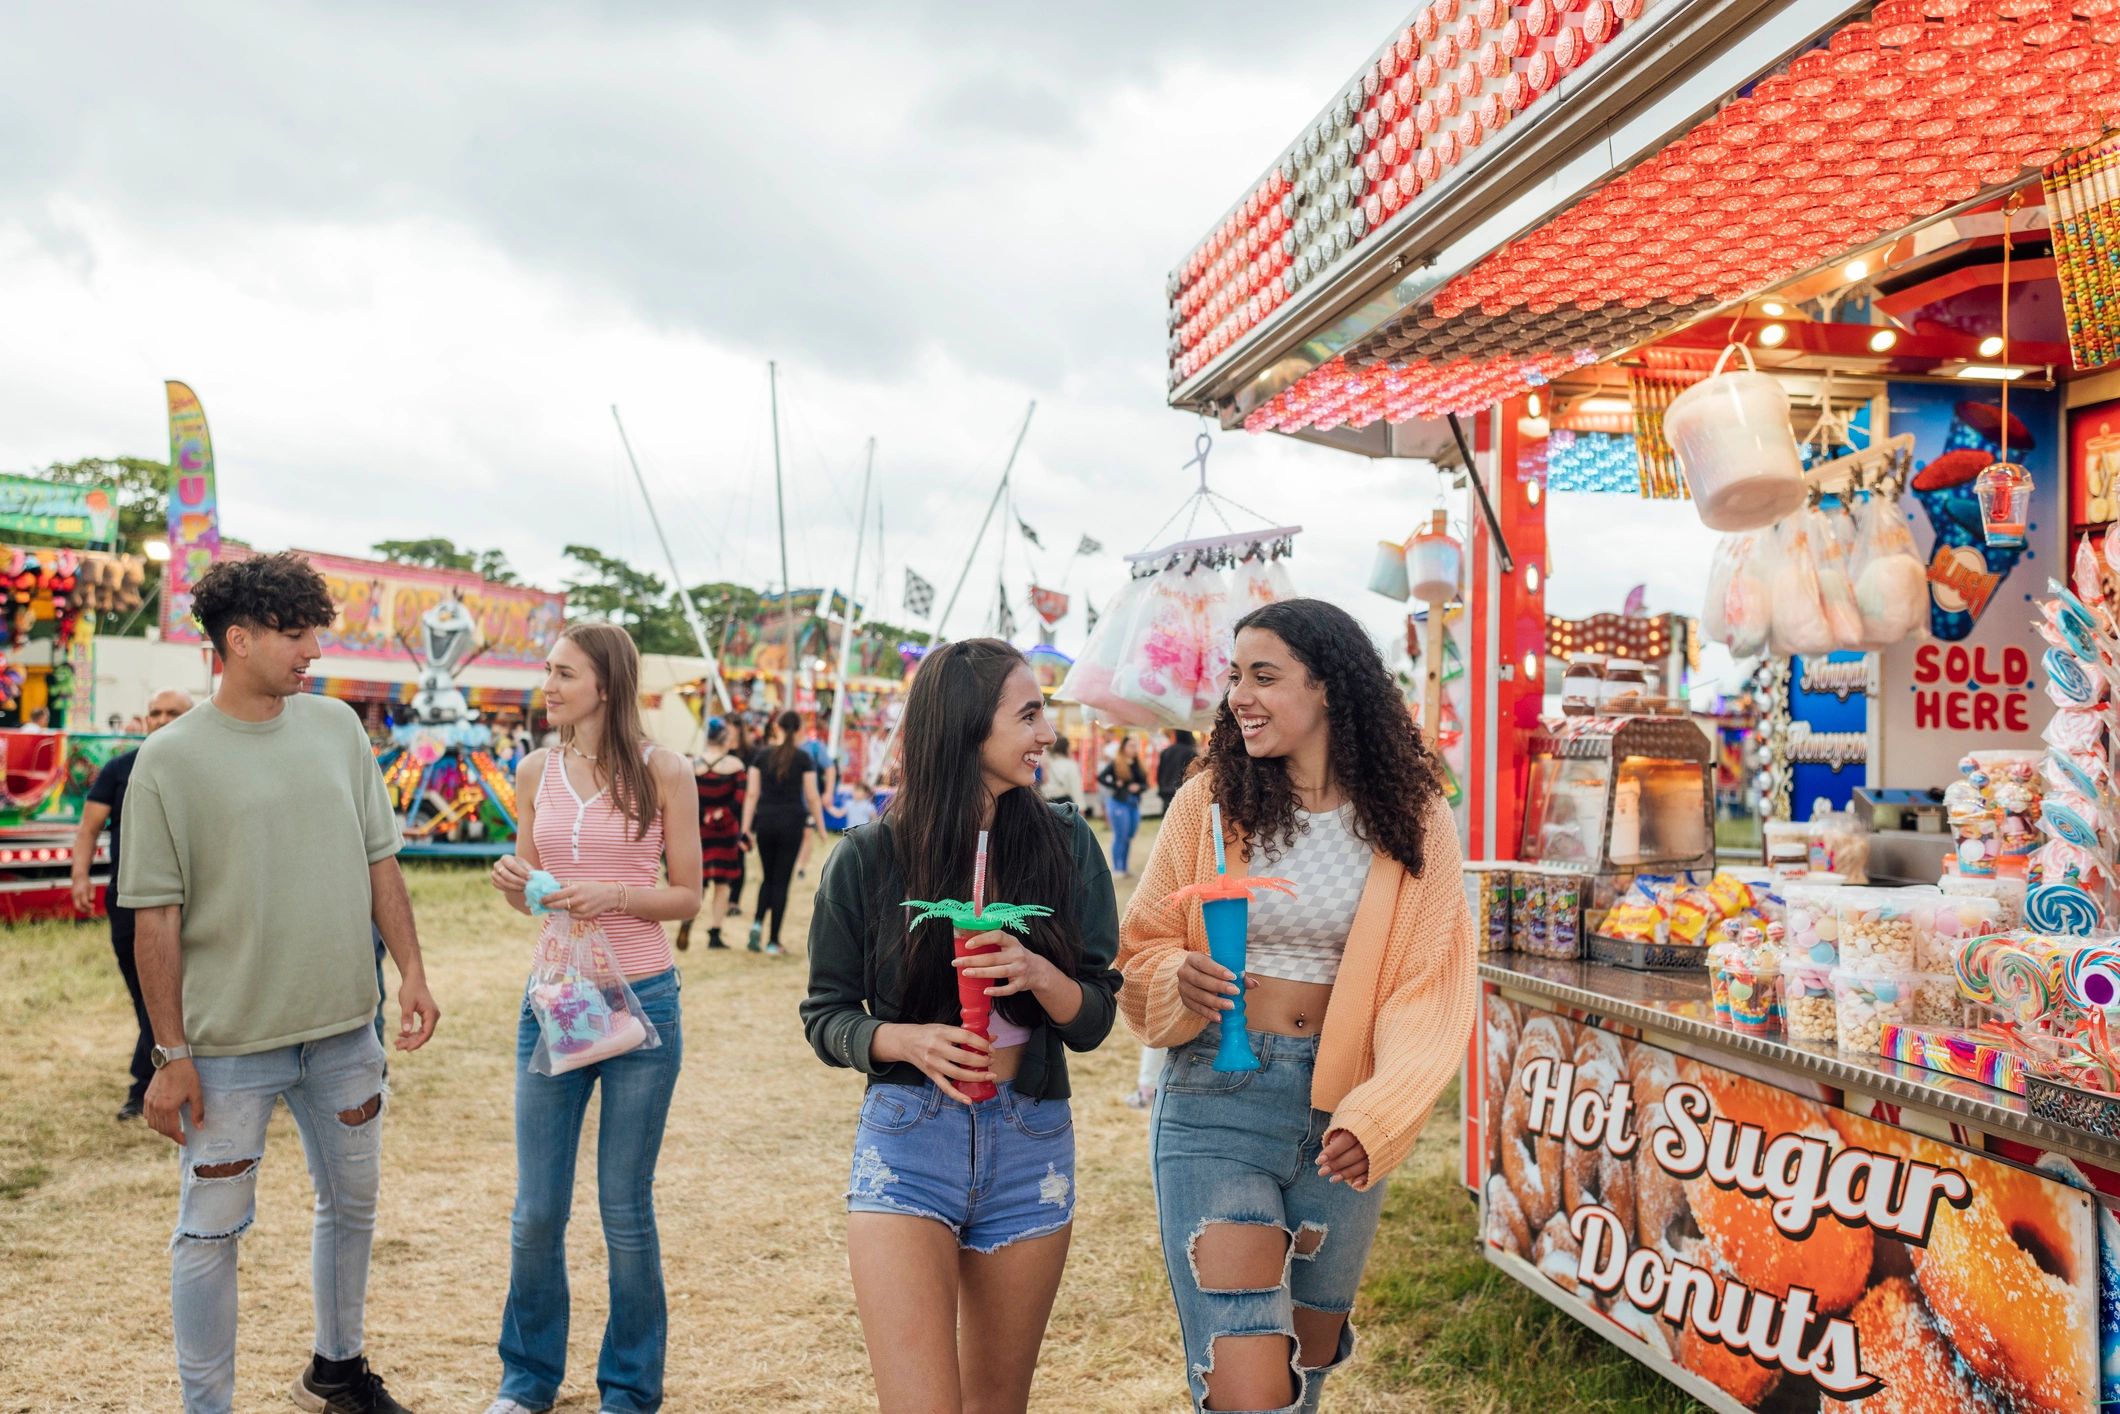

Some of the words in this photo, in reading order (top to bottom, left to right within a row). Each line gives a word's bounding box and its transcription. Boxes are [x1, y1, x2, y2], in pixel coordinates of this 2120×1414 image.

[1926, 544, 2001, 620] SLUSH
[1914, 644, 2028, 686] SOLD
[1915, 690, 2029, 732] HERE
[1520, 1055, 1640, 1158] Hot
[1651, 1082, 1973, 1249] Sugar
[1570, 1202, 1888, 1400] Donuts
